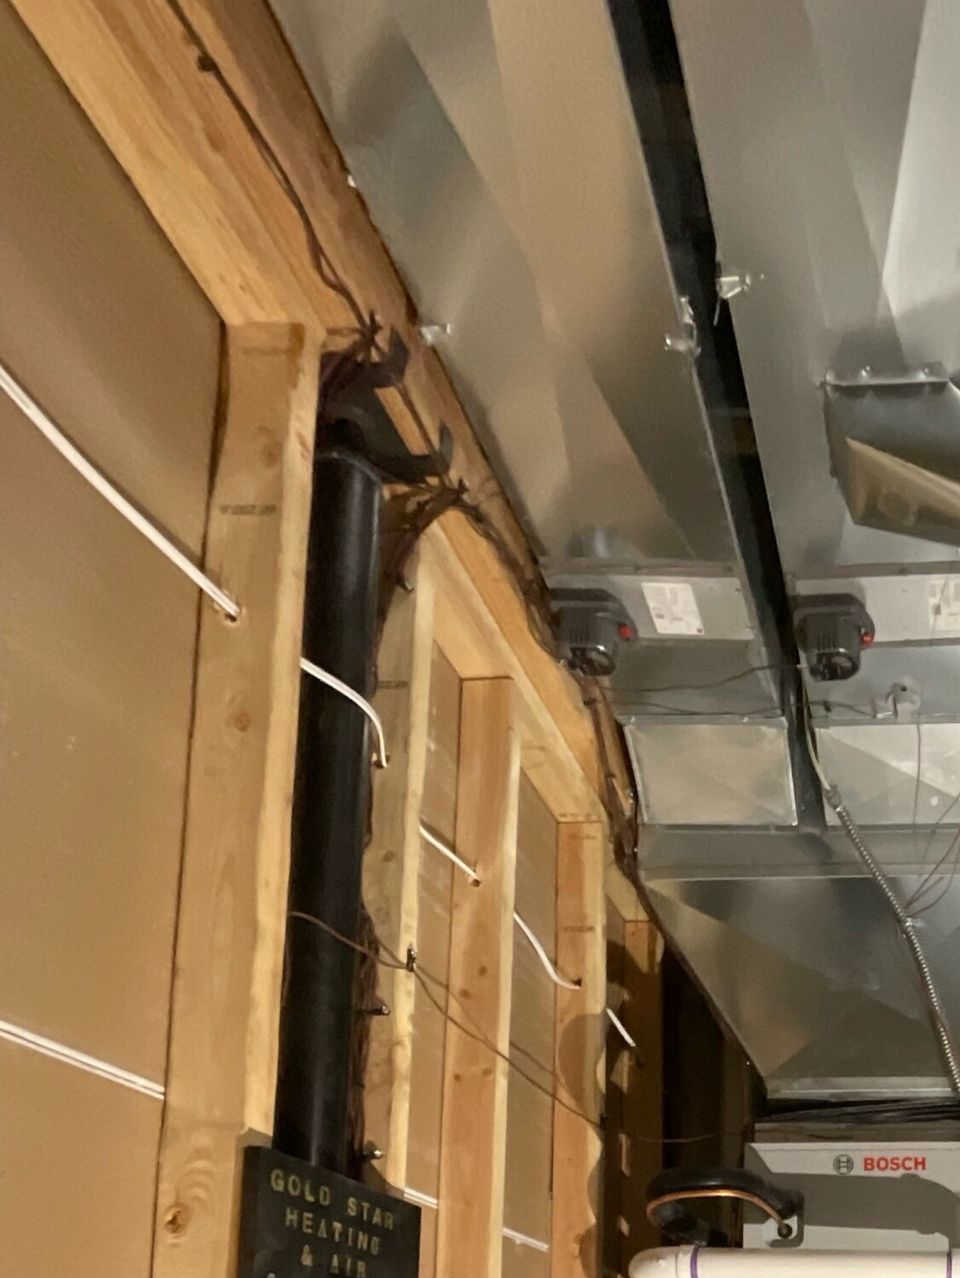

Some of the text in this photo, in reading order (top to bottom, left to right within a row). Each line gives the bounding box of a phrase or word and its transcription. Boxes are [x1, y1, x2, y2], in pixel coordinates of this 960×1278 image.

[863, 1156, 927, 1172] BOSCH
[270, 1168, 394, 1231] GOLD STAR
[285, 1206, 381, 1256] HEATING
[301, 1244, 314, 1268] &
